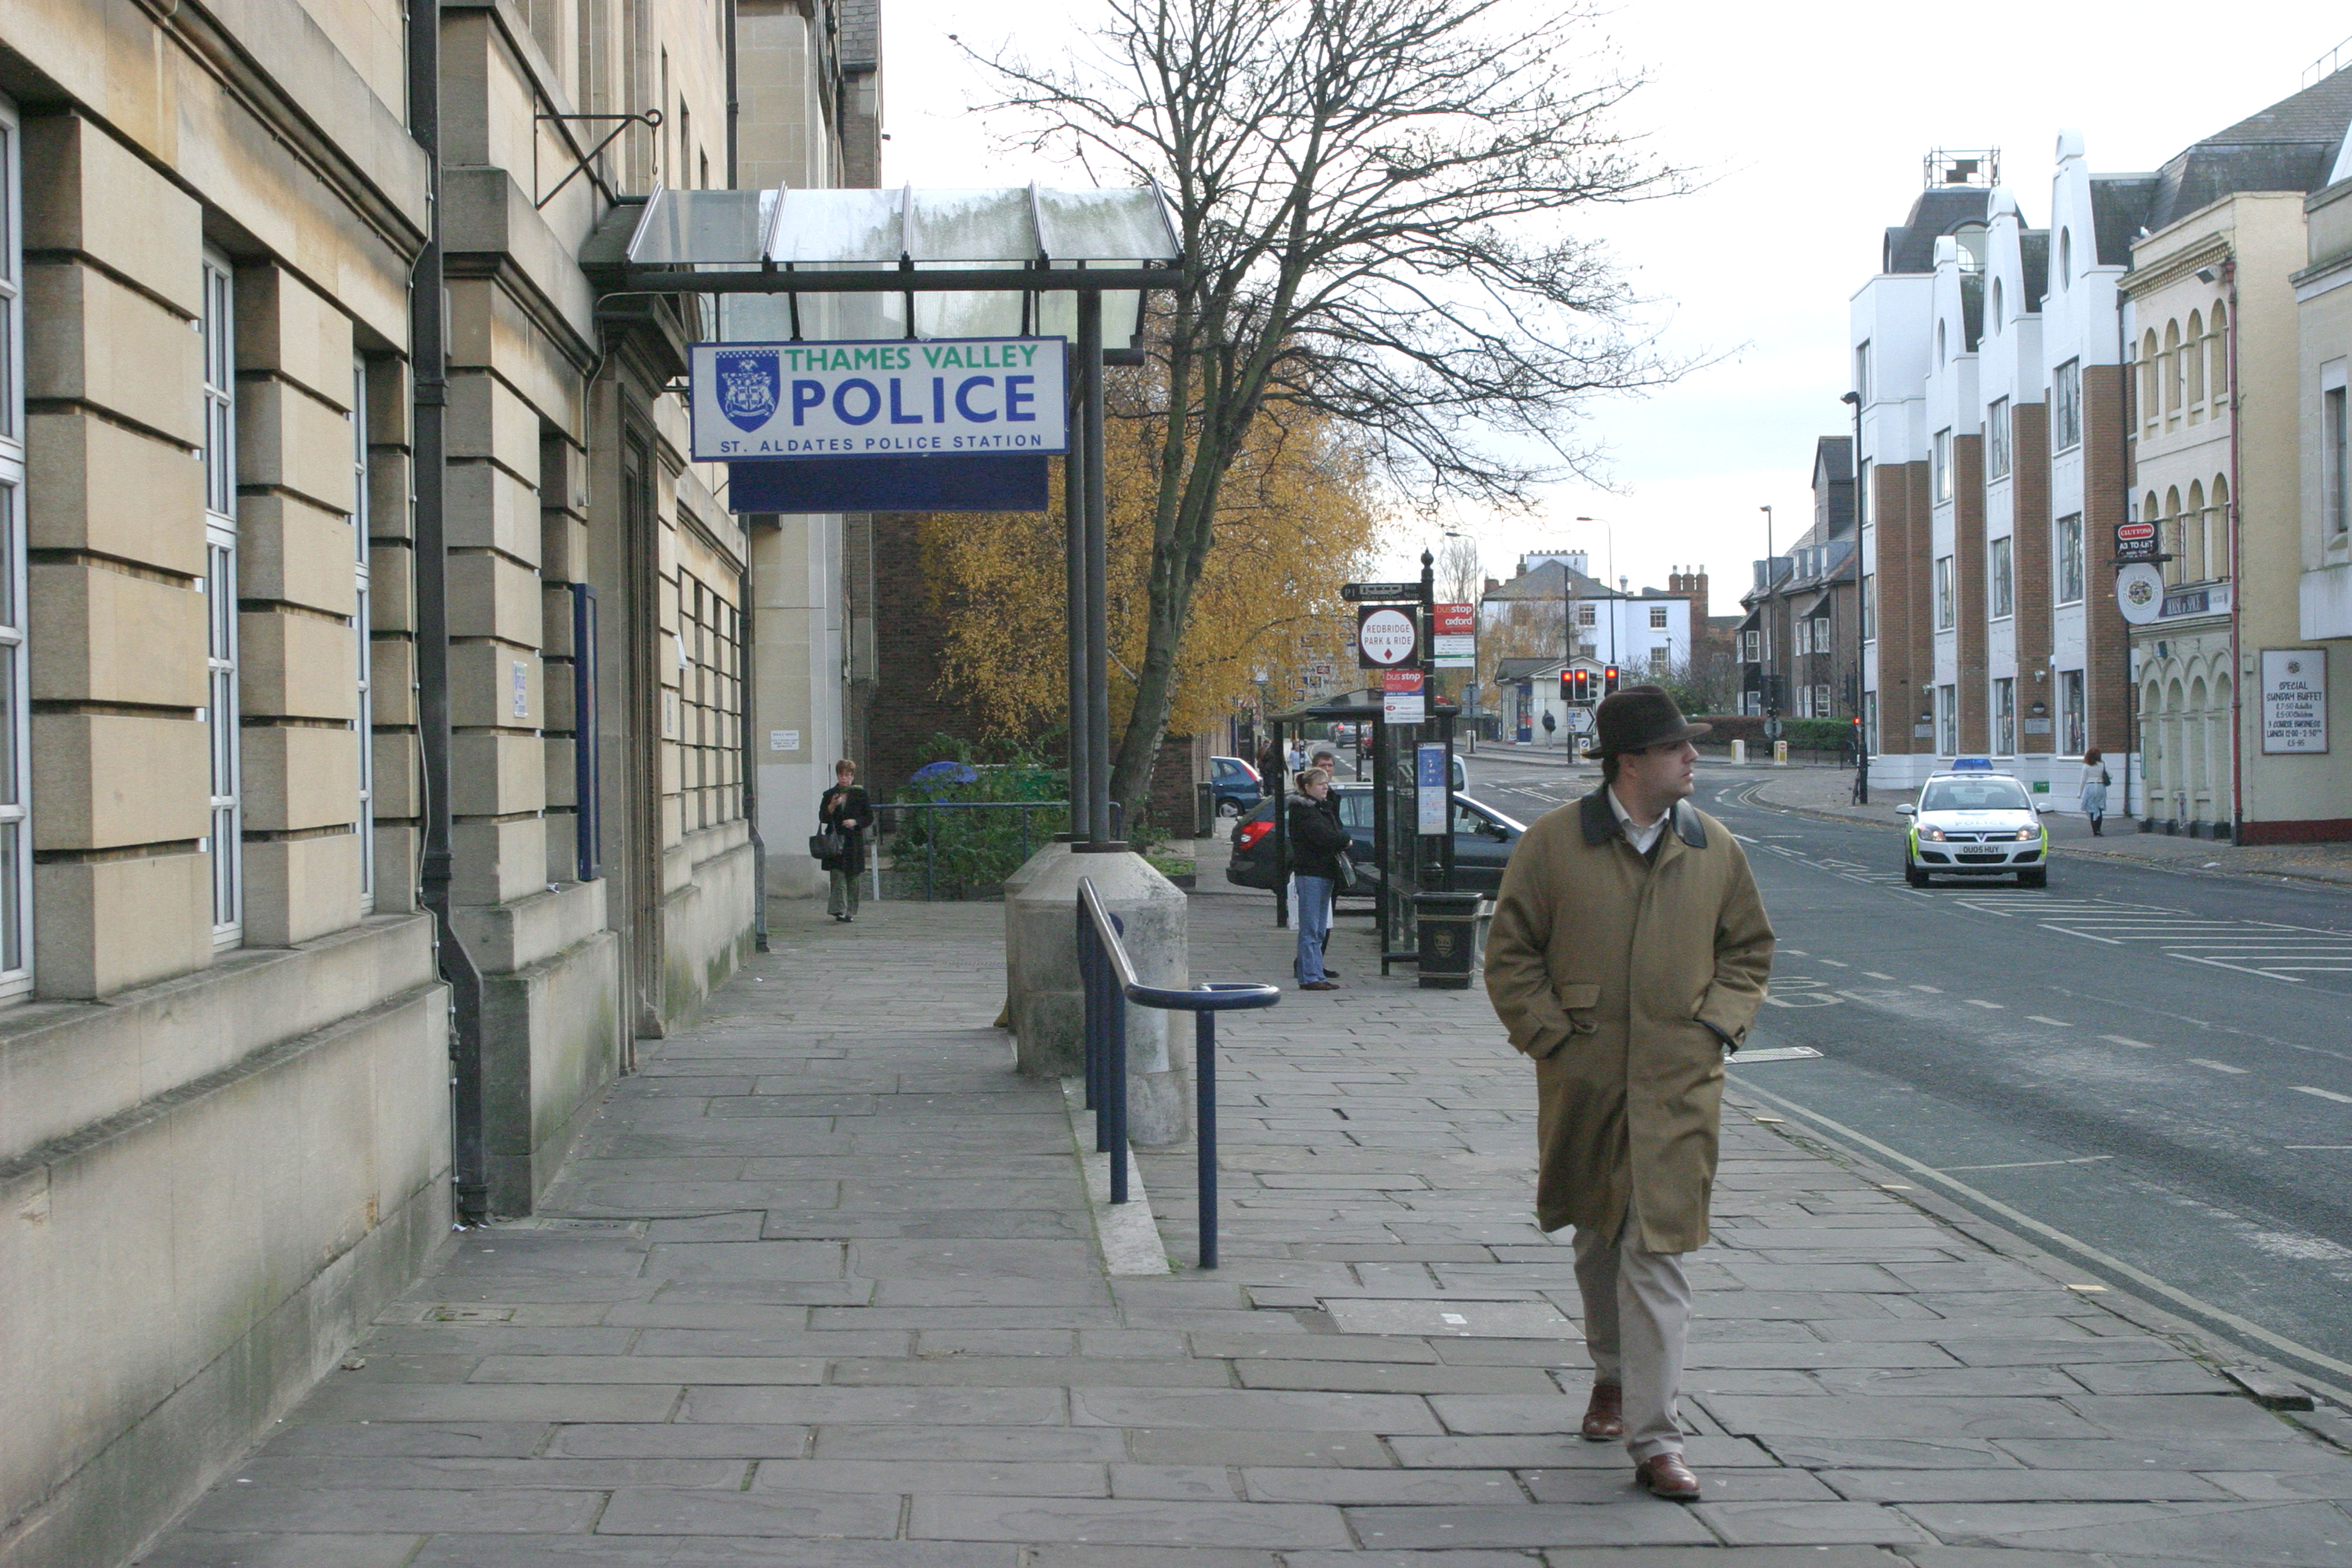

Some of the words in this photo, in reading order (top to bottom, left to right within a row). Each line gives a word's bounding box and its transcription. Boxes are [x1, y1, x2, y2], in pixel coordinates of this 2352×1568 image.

[786, 347, 911, 372] THAMES
[922, 345, 1039, 368] VALLEY
[792, 375, 1037, 426] POLICE
[720, 441, 747, 453] ST.
[760, 438, 853, 452] ALDATES
[865, 436, 941, 450] POLICE
[953, 434, 1041, 448] STATION
[1445, 616, 1472, 625] oxford
[1367, 624, 1410, 633] REDBRIDGE
[1394, 636, 1411, 645] RIDE
[1386, 672, 1400, 680] bus
[1401, 672, 1421, 682] stop
[2279, 681, 2308, 690] SPECIAL
[2267, 692, 2295, 701] SUNDAY
[2297, 692, 2322, 701] BUFFET
